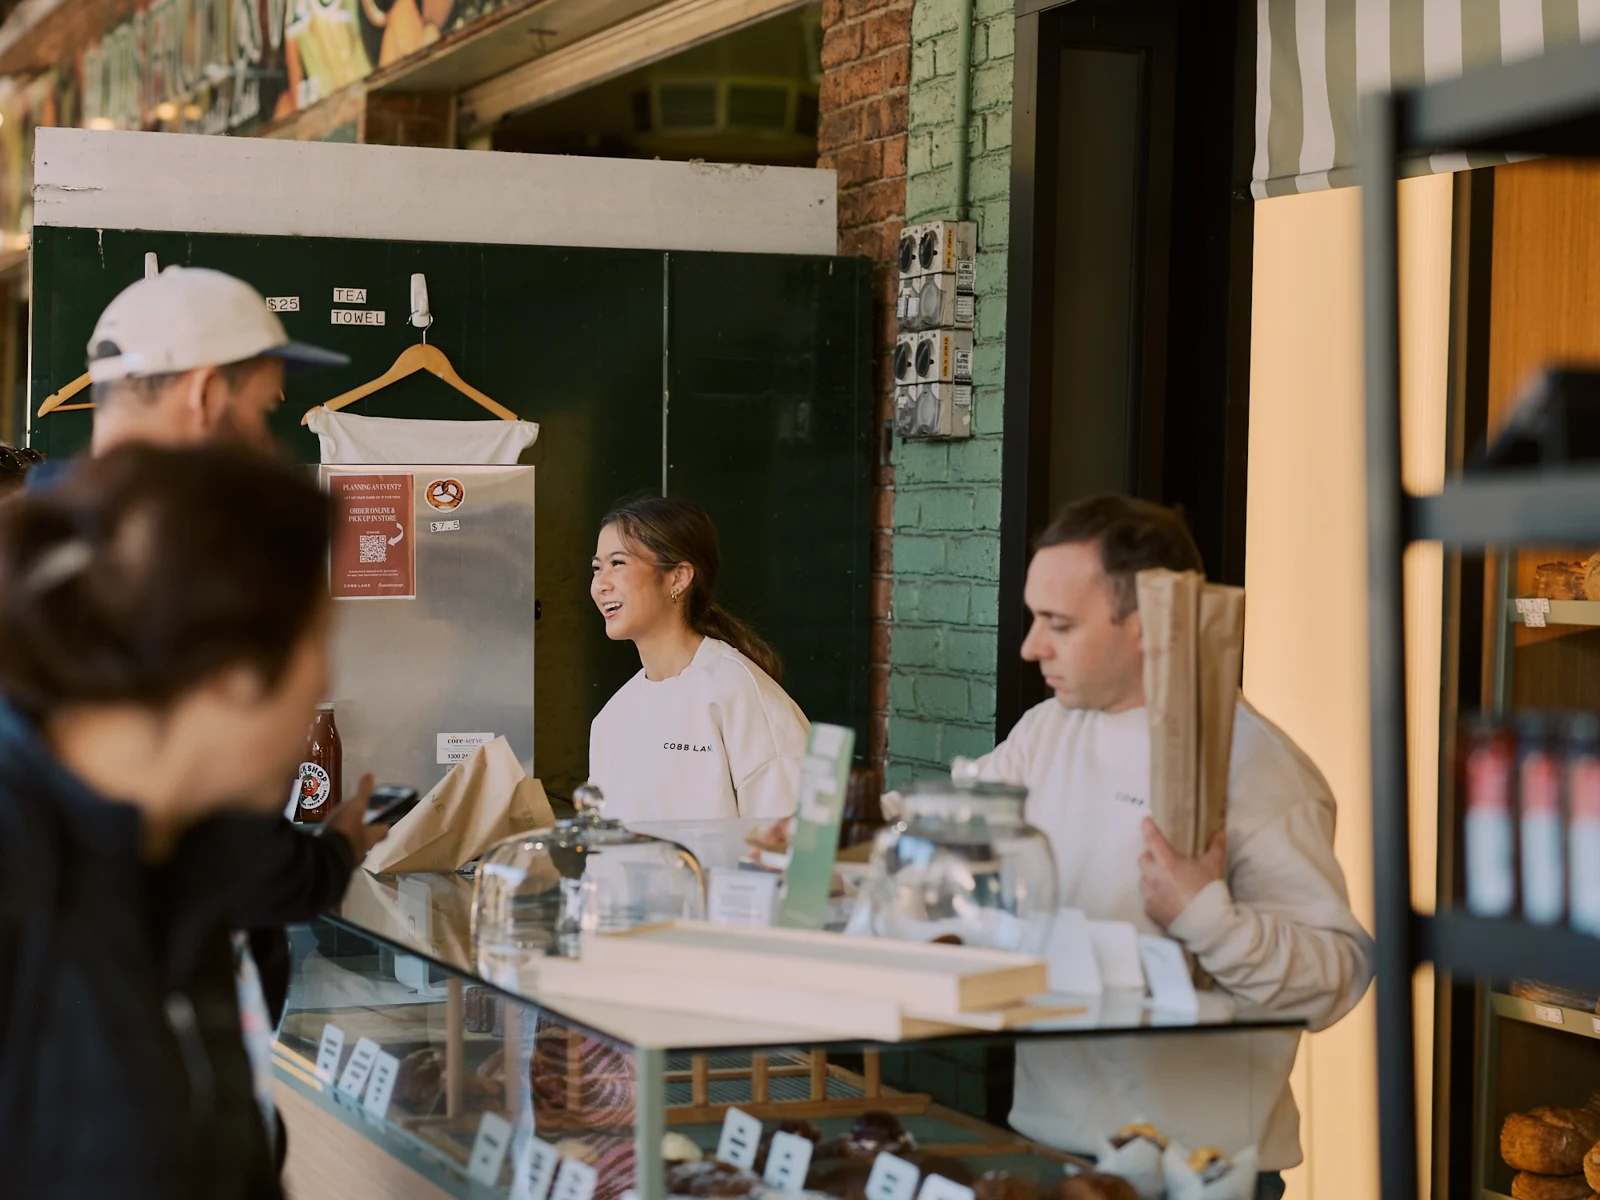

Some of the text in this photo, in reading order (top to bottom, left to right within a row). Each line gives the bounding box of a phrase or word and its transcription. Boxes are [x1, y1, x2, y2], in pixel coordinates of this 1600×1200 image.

[335, 289, 365, 302] TEA
[267, 298, 298, 311] $25
[333, 311, 384, 324] TOWEL
[431, 521, 460, 532] $7.5
[1517, 600, 1549, 612] OLIVE
[663, 742, 690, 751] COBB
